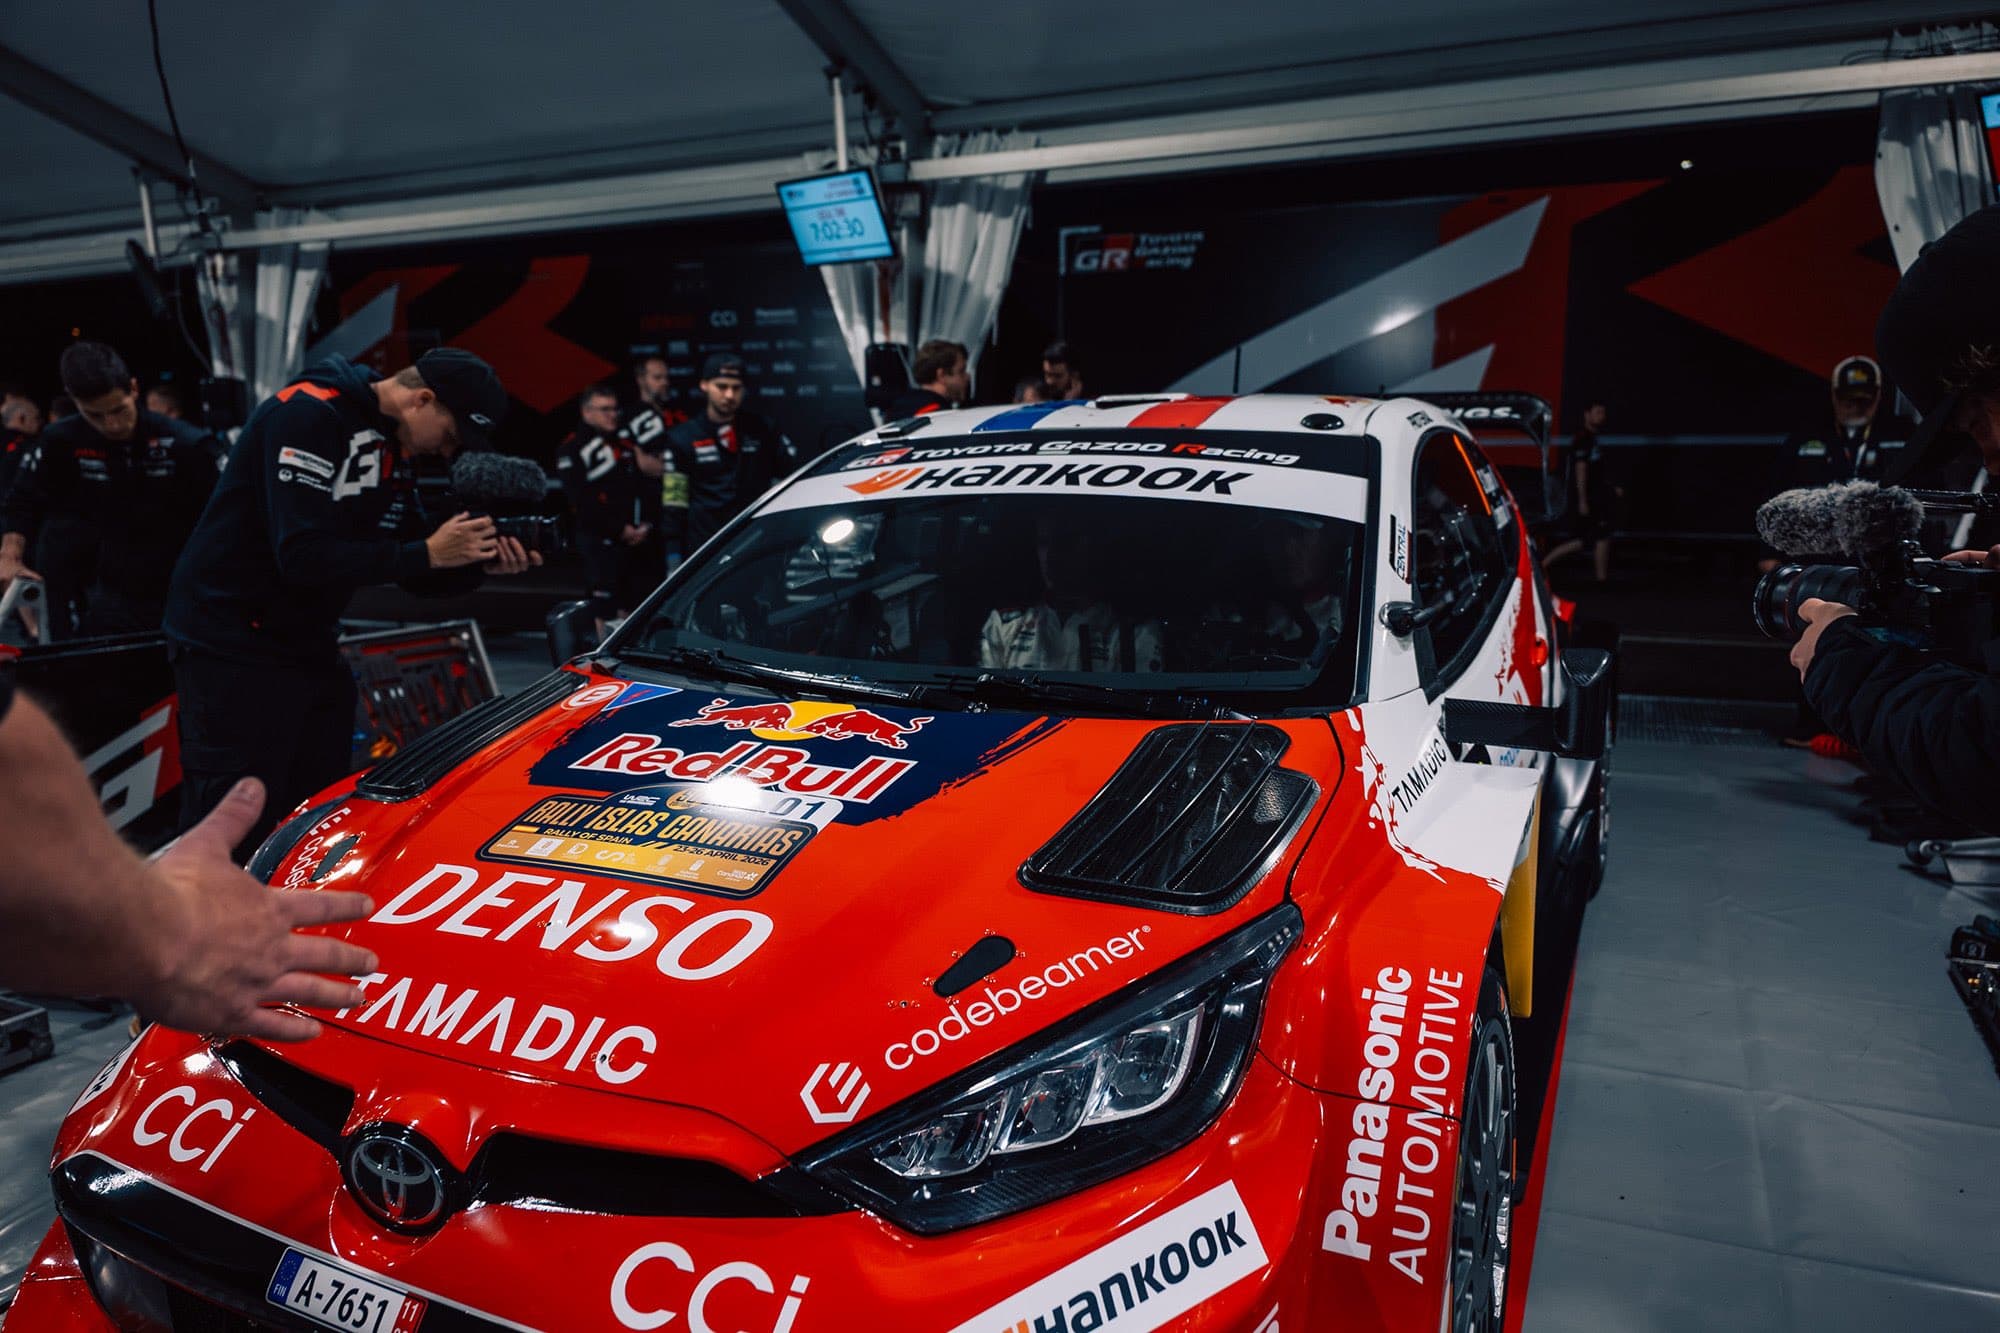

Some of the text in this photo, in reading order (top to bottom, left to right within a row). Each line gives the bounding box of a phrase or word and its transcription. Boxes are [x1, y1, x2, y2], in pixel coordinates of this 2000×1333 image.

[1073, 248, 1131, 272] GR
[910, 443, 1033, 460] TOYOTA
[1036, 440, 1168, 457] GAZOO
[1172, 442, 1301, 466] Racing
[568, 733, 918, 805] Red Bull
[1391, 738, 1447, 813] TAMADIC
[522, 800, 808, 857] RALLY ISLAS CANARIAS
[543, 828, 634, 845] RALLY OF SPAIN
[674, 844, 771, 866] 23-26 APRIL 2026
[367, 863, 774, 980] DENSO
[335, 972, 658, 1085] TAMADIC
[1321, 966, 1414, 1262] Panasonic
[1388, 967, 1464, 1285] AUTOMOTIVE
[273, 1282, 288, 1297] FIN
[294, 1269, 390, 1333] A-7651
[402, 1300, 419, 1322] 11
